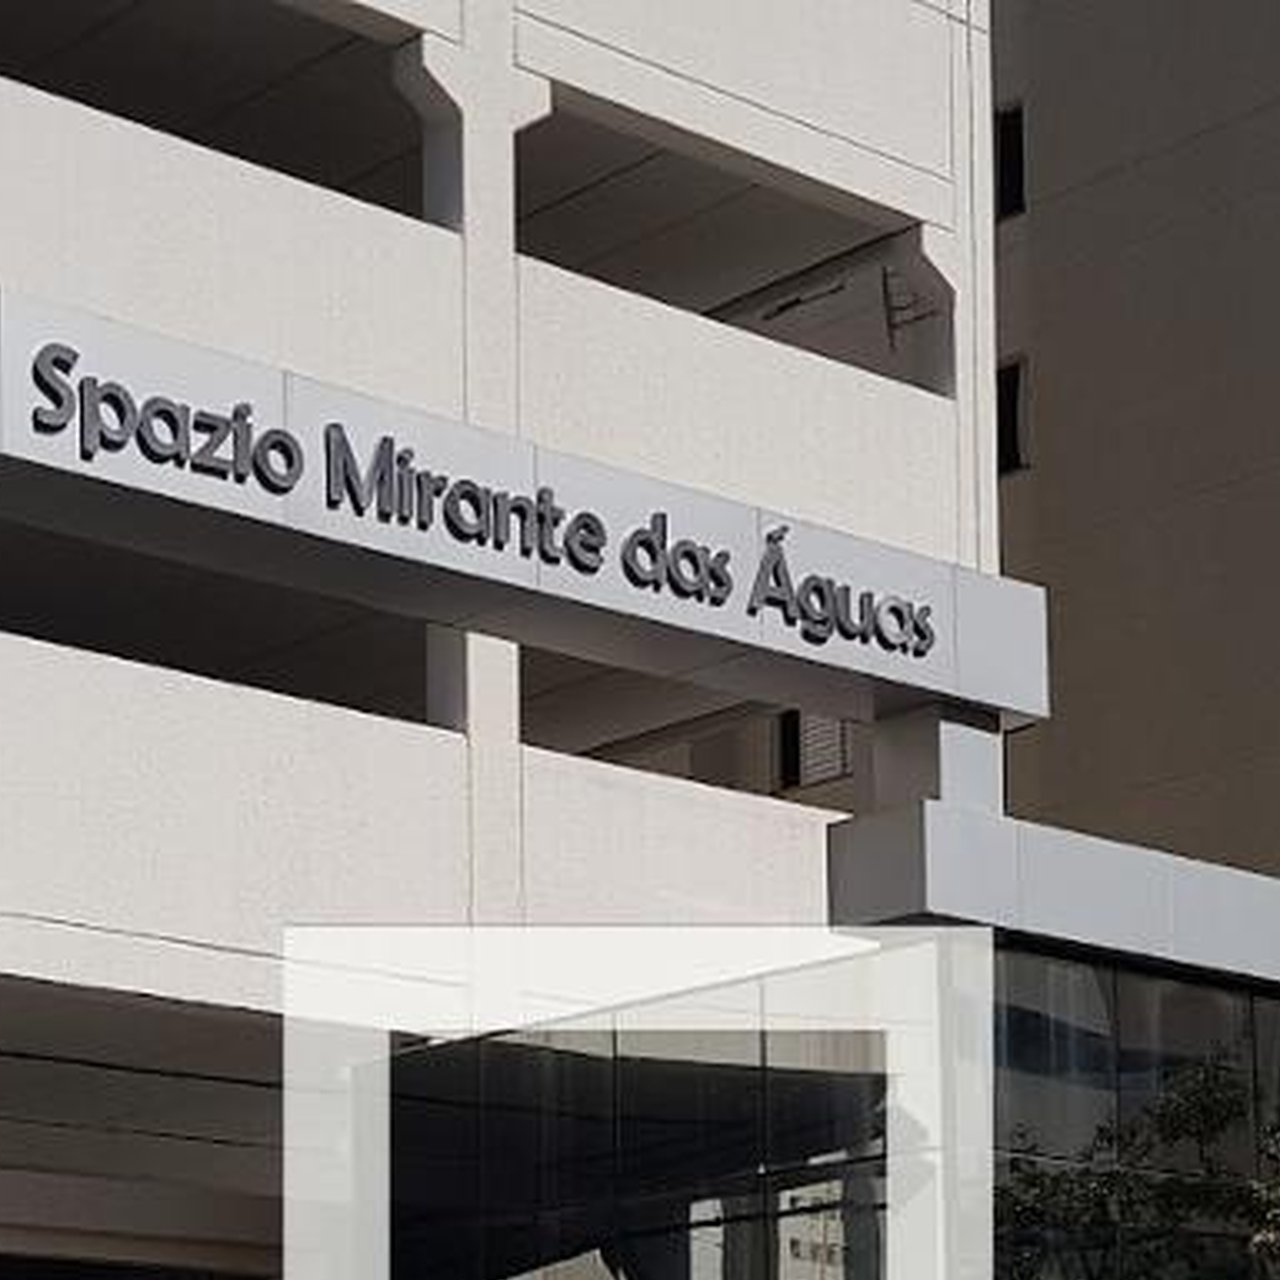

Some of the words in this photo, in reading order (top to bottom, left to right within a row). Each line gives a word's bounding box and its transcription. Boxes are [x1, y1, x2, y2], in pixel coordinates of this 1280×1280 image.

[32, 342, 304, 496] Spazio
[325, 422, 607, 576] Mirante
[621, 512, 733, 607] das
[746, 525, 935, 658] Águas
